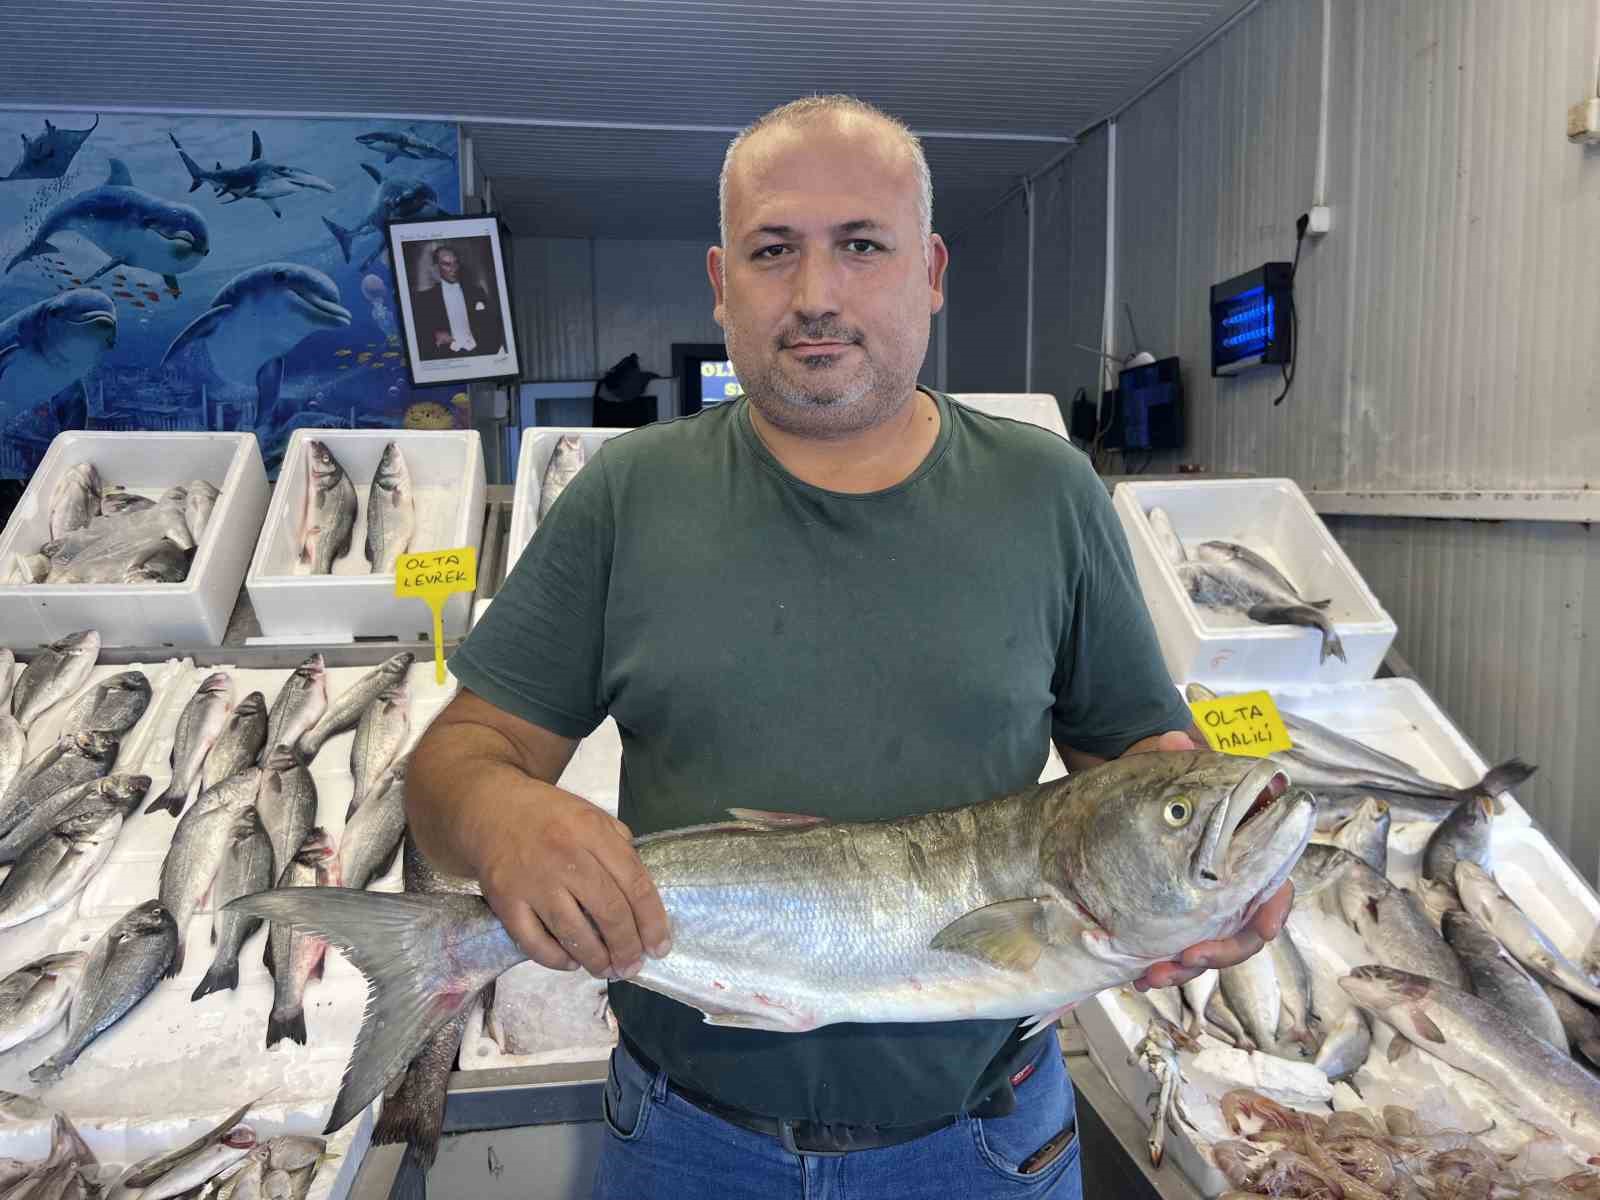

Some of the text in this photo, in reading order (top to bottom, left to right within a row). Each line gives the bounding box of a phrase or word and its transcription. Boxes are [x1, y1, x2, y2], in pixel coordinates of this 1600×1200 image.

[405, 554, 460, 570] OLTA
[403, 570, 467, 588] LEVREK
[1204, 704, 1263, 727] OLTA
